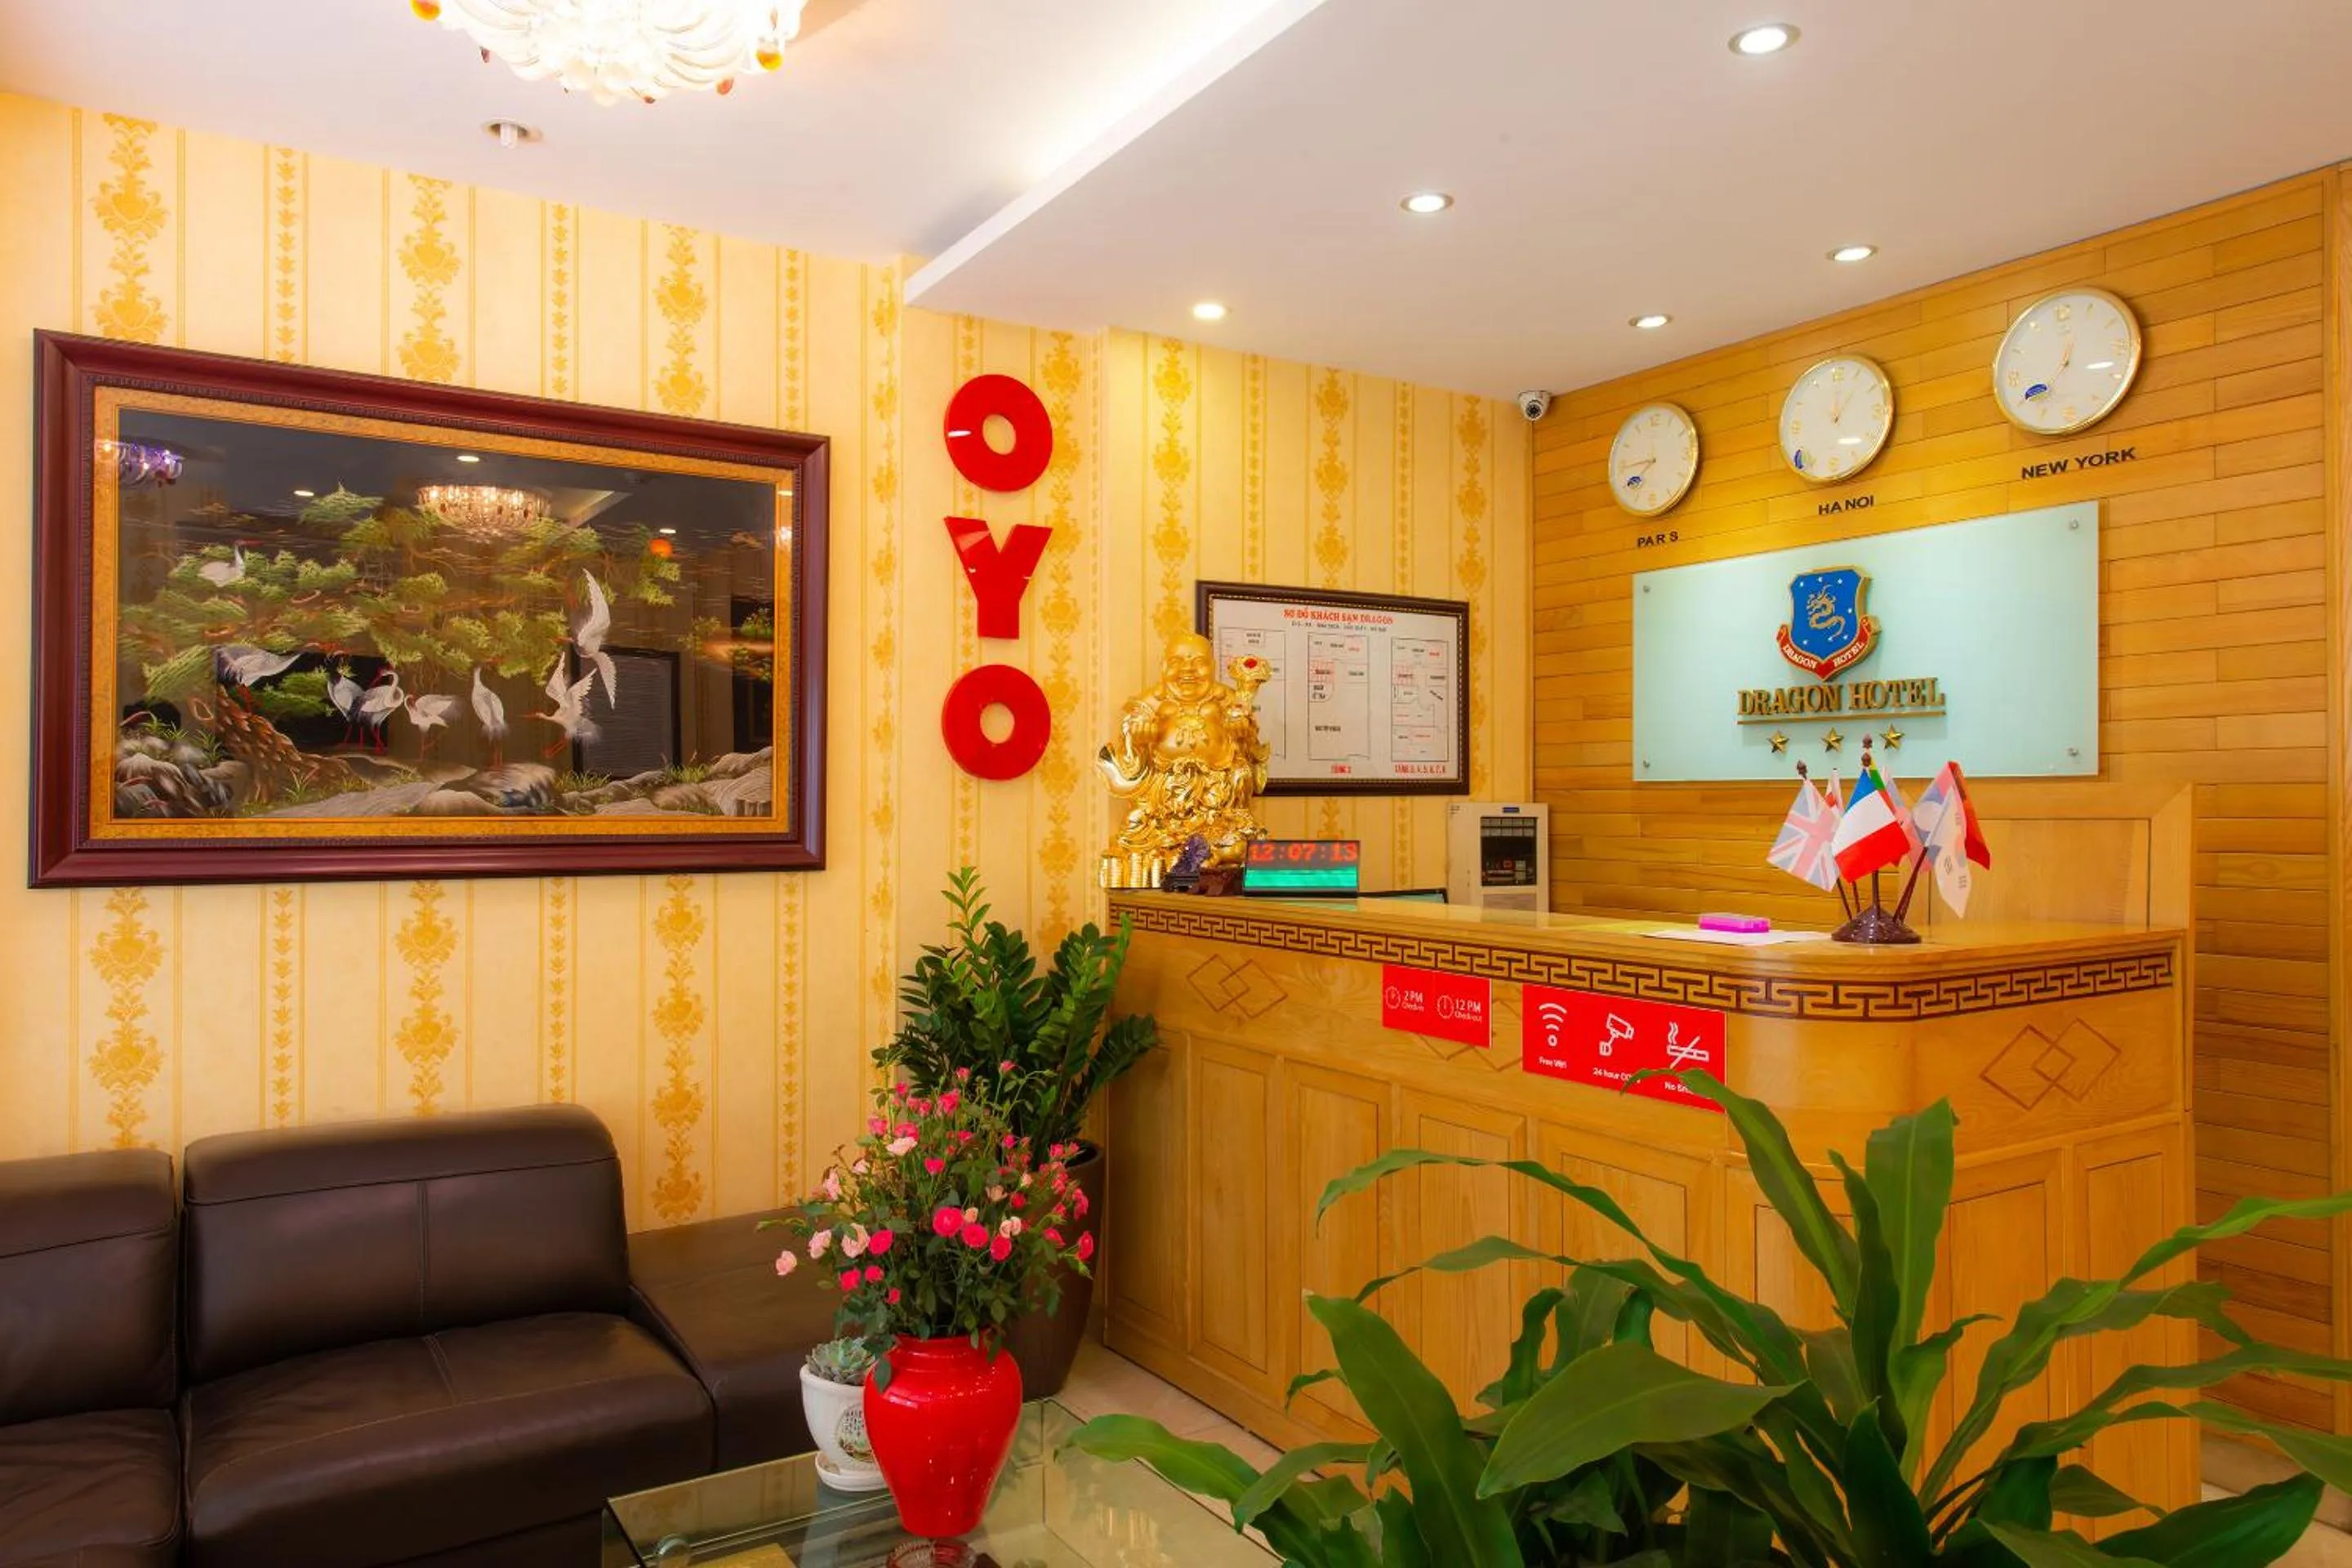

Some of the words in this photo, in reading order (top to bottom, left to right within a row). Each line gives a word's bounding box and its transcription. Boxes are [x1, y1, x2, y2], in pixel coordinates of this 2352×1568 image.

[2021, 459, 2069, 479] NEW
[2074, 447, 2136, 470] YORK
[1818, 495, 1874, 515] HANOI
[942, 374, 1054, 781] OYO
[1782, 644, 1818, 669] DRAGON
[1833, 641, 1865, 667] HOTEL
[1737, 684, 1843, 716] DRAGON
[1847, 677, 1947, 711] HOTEL
[1410, 991, 1423, 1004] PM
[1455, 999, 1465, 1011] 12
[1467, 1000, 1481, 1013] PM
[1592, 1067, 1602, 1076] 24
[1603, 1070, 1619, 1080] hour
[1664, 1081, 1676, 1091] No
